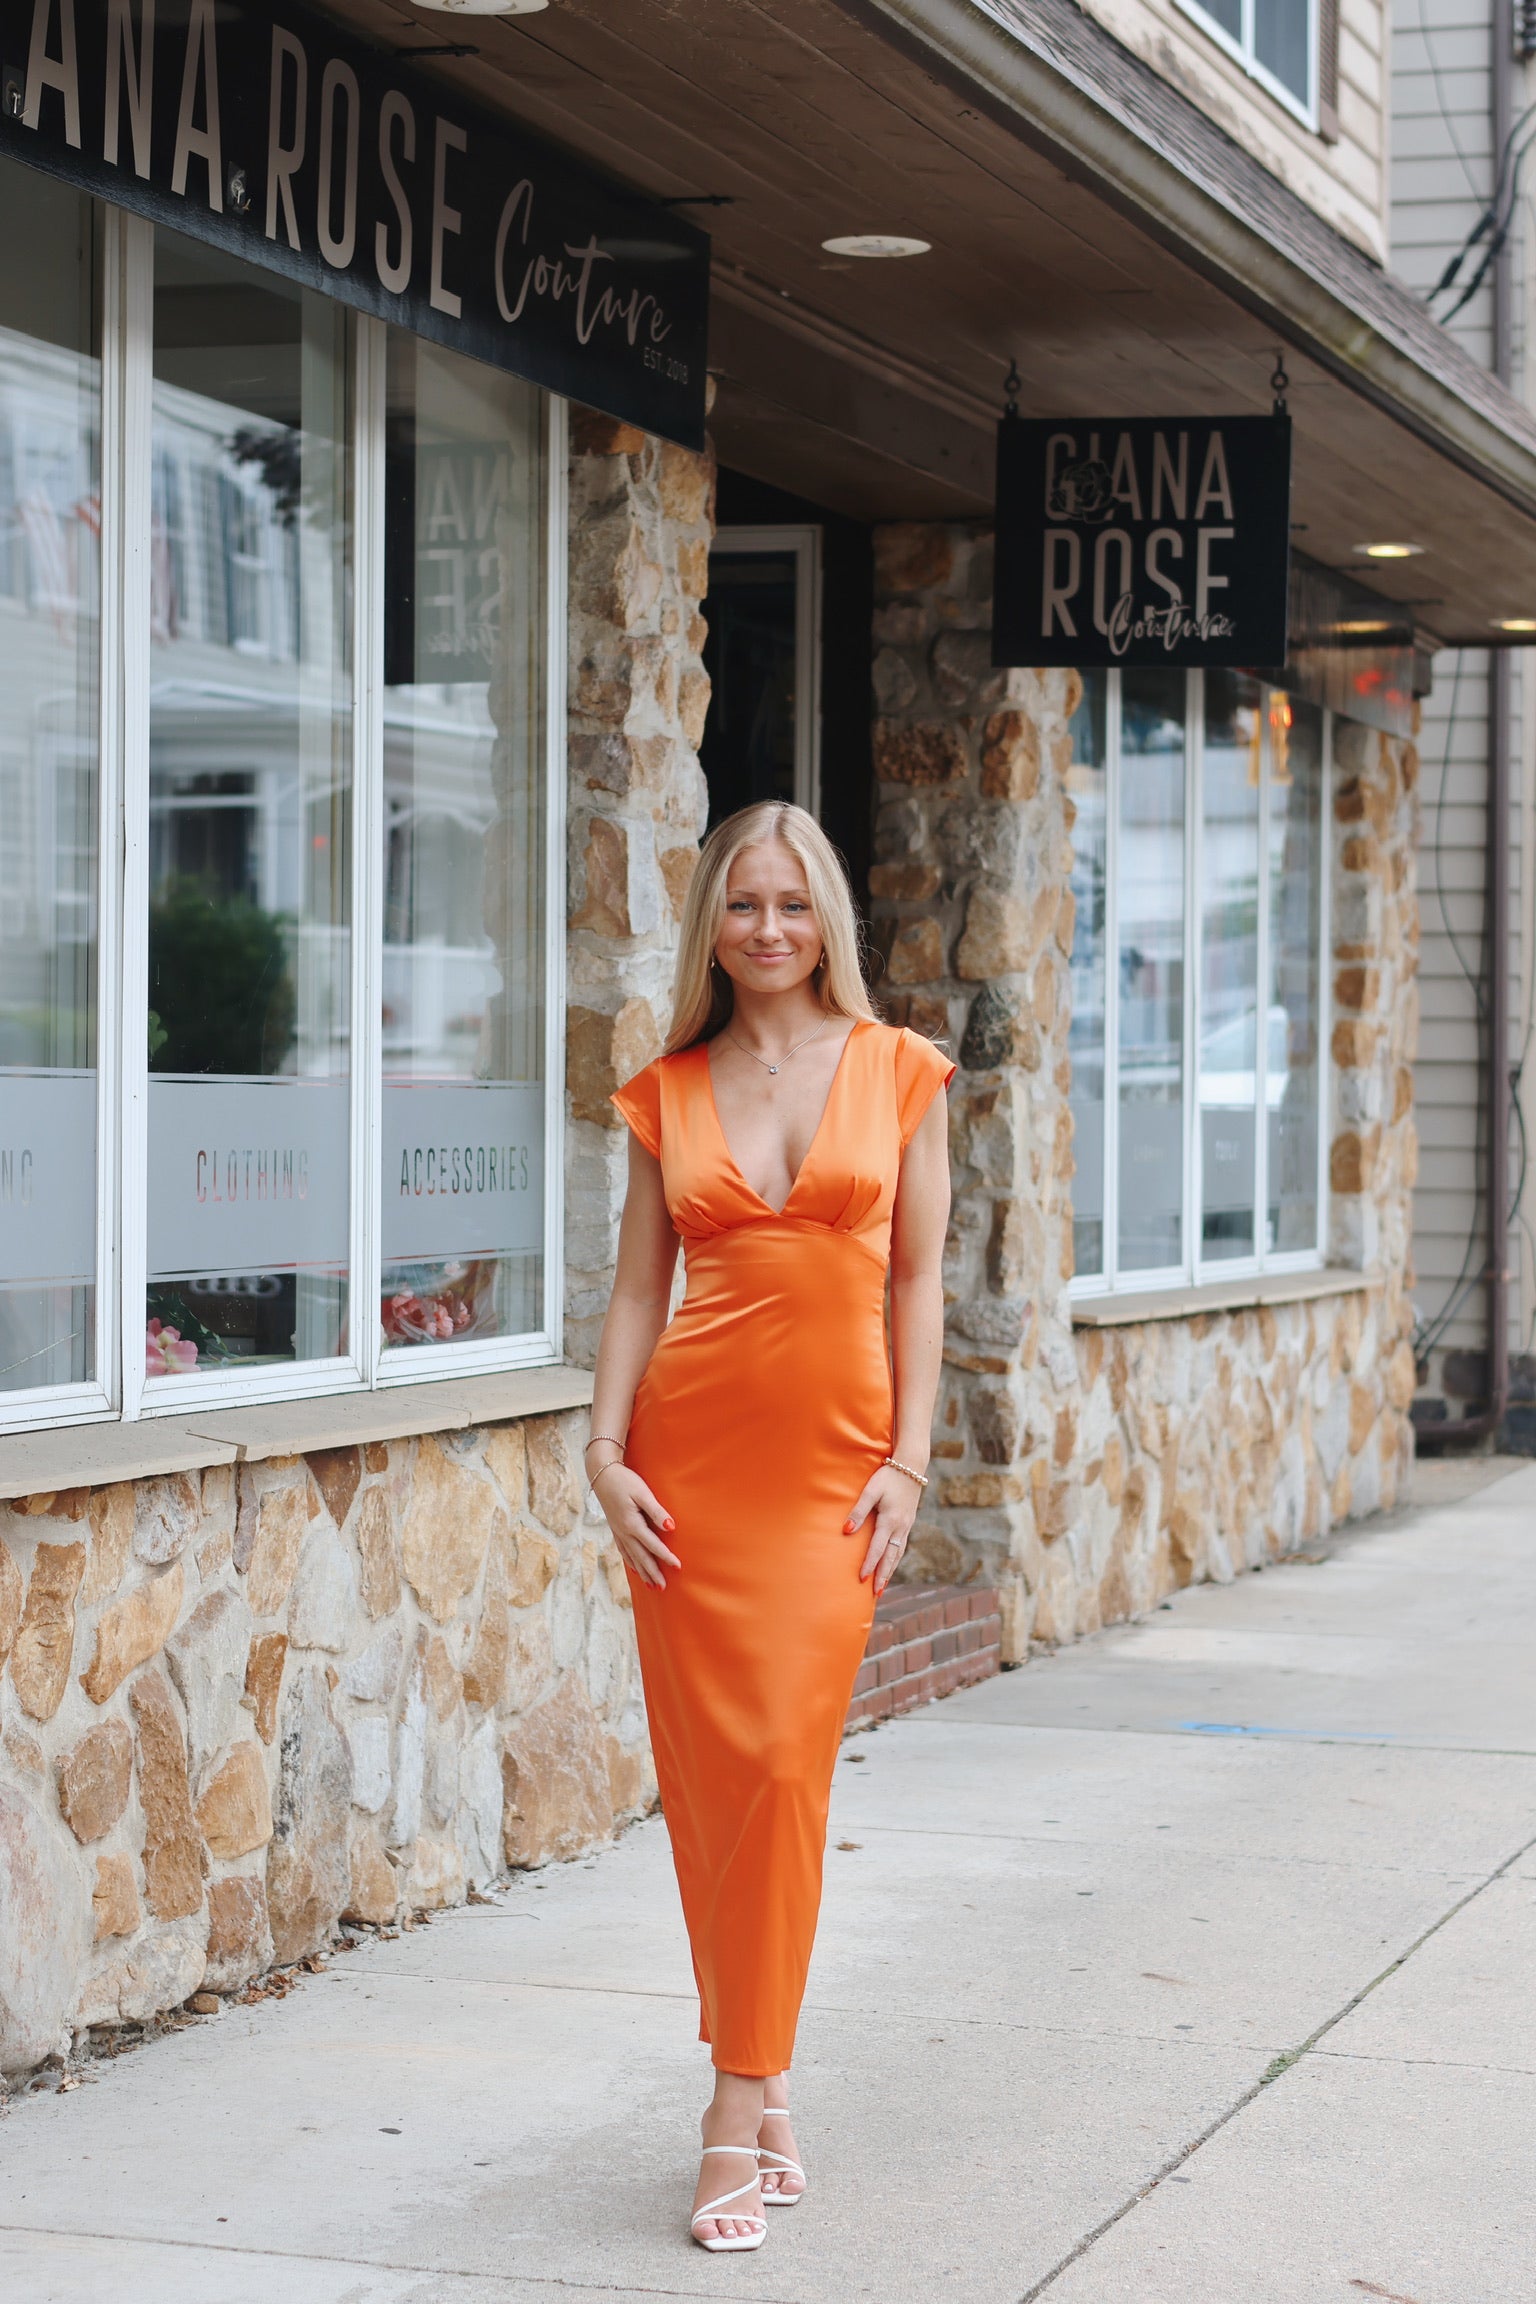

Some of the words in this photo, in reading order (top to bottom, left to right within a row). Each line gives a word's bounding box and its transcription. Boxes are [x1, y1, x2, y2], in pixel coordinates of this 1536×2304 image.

[264, 23, 467, 320] ROSE
[494, 178, 673, 346] Couture
[1041, 527, 1235, 638] ROSE
[1108, 591, 1236, 656] Couture
[195, 1148, 309, 1203] CLOTHING
[400, 1145, 529, 1196] ACCESSORIES
